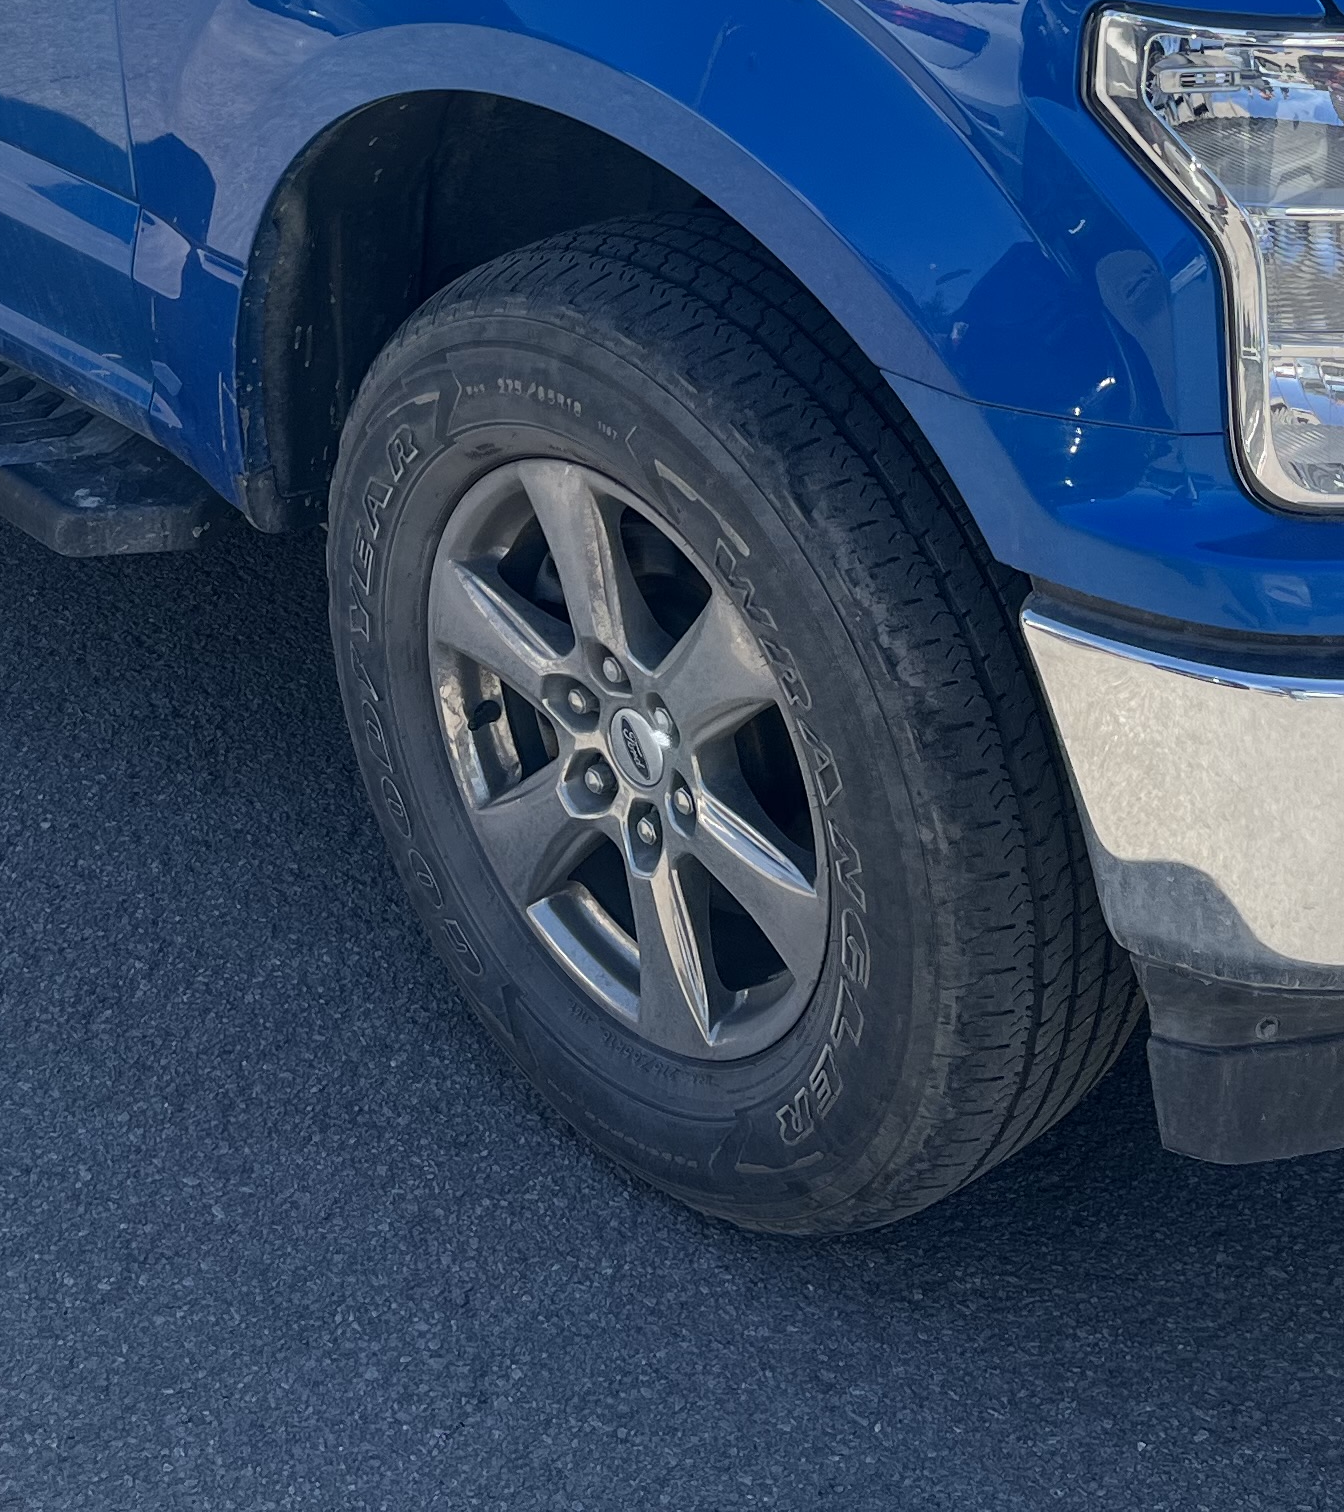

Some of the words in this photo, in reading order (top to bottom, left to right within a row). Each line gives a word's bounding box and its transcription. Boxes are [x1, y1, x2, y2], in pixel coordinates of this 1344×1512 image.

[347, 424, 485, 978] GOODYEAR
[622, 728, 646, 770] Ford
[715, 538, 871, 1146] WRANGLER
